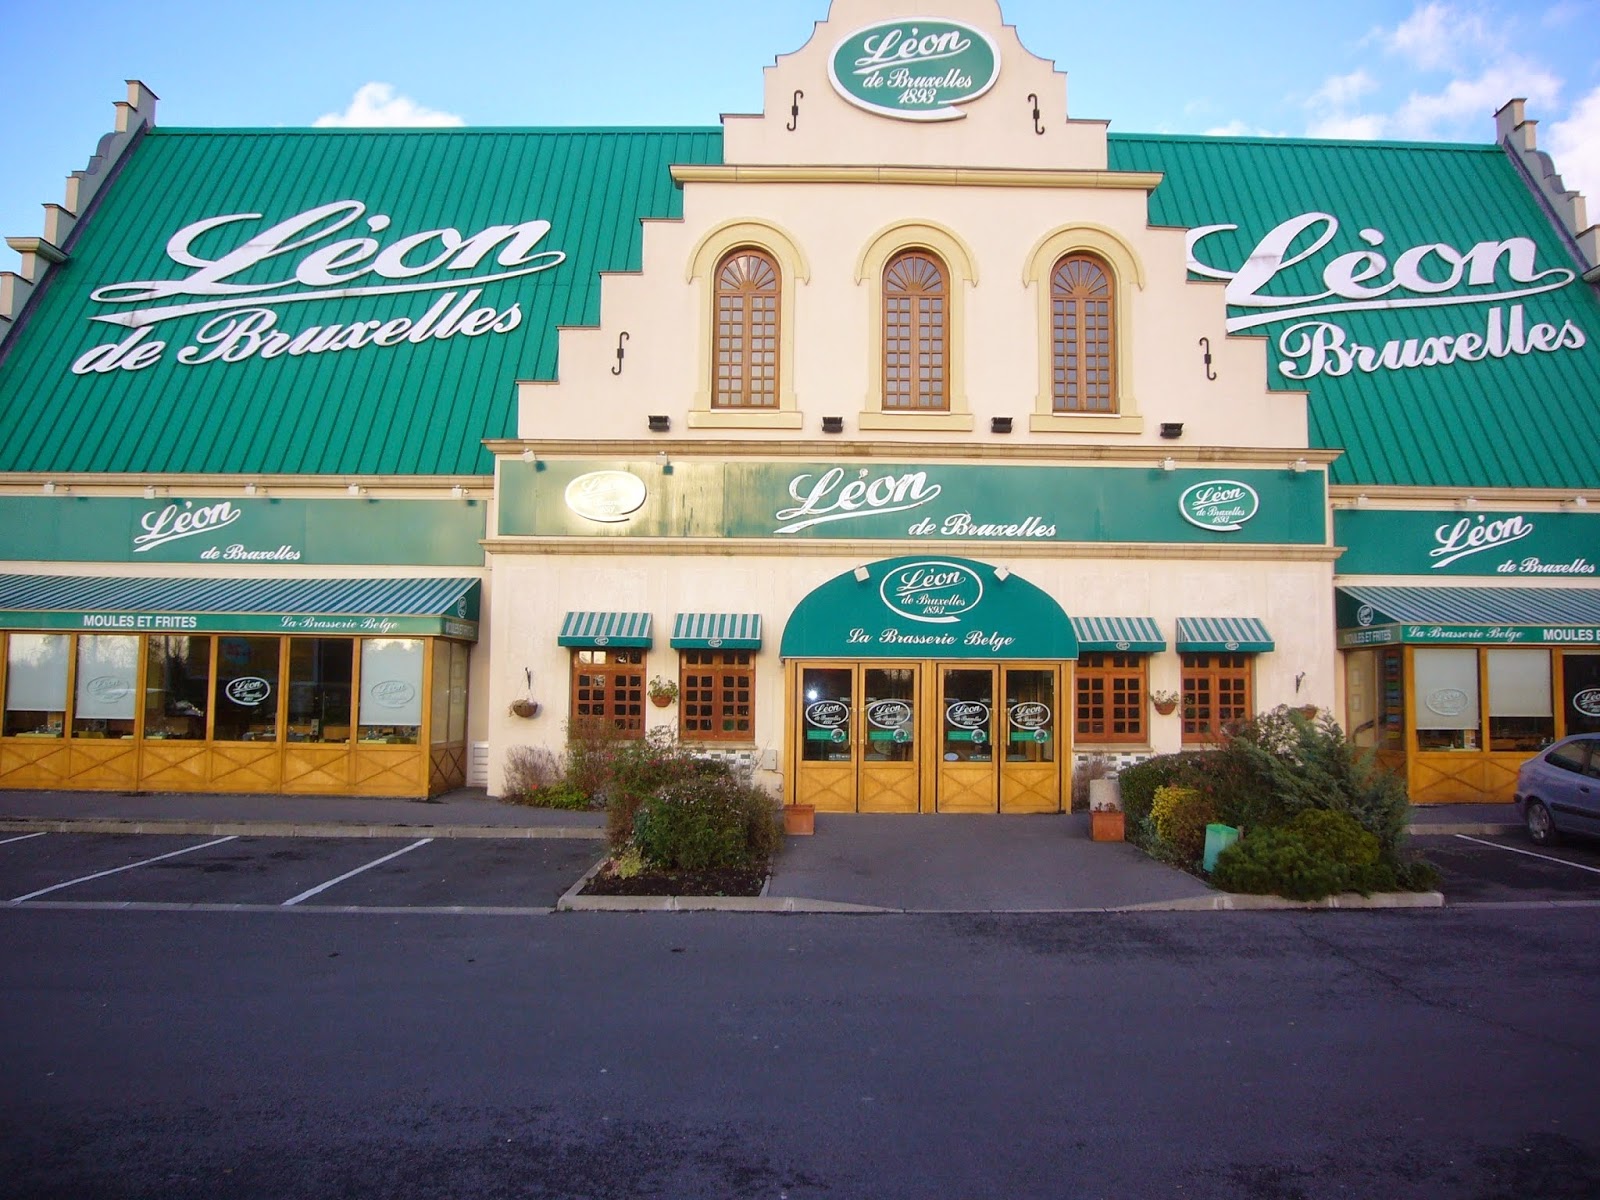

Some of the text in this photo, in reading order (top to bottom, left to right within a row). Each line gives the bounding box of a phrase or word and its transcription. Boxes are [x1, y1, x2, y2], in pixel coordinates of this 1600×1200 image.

[853, 27, 971, 74] Léon
[862, 67, 972, 88] de Bruxelles
[898, 88, 936, 104] 1893
[86, 199, 566, 327] Léon
[1186, 211, 1575, 332] Léon
[71, 288, 523, 376] de Bruxelles
[1278, 303, 1586, 380] Bruxelles
[773, 467, 941, 533] Léon
[1191, 486, 1246, 510] Léon
[1207, 505, 1245, 517] Bruxelles
[133, 500, 242, 553] Léon
[908, 510, 1057, 538] de Bruxelles
[200, 543, 302, 561] de Bruxelles
[1429, 515, 1534, 569] Léon
[1497, 556, 1596, 574] de Bruxelles
[895, 568, 967, 597] Léon
[901, 593, 967, 606] de Bruxelles
[922, 605, 945, 615] 1893
[83, 615, 197, 628] MOULES ET FRITES
[280, 616, 399, 633] La Brasserie Belge
[1407, 625, 1525, 642] La Brasserie Belge
[847, 628, 1016, 652] La Brasserie Belge
[1543, 629, 1594, 641] MOULES
